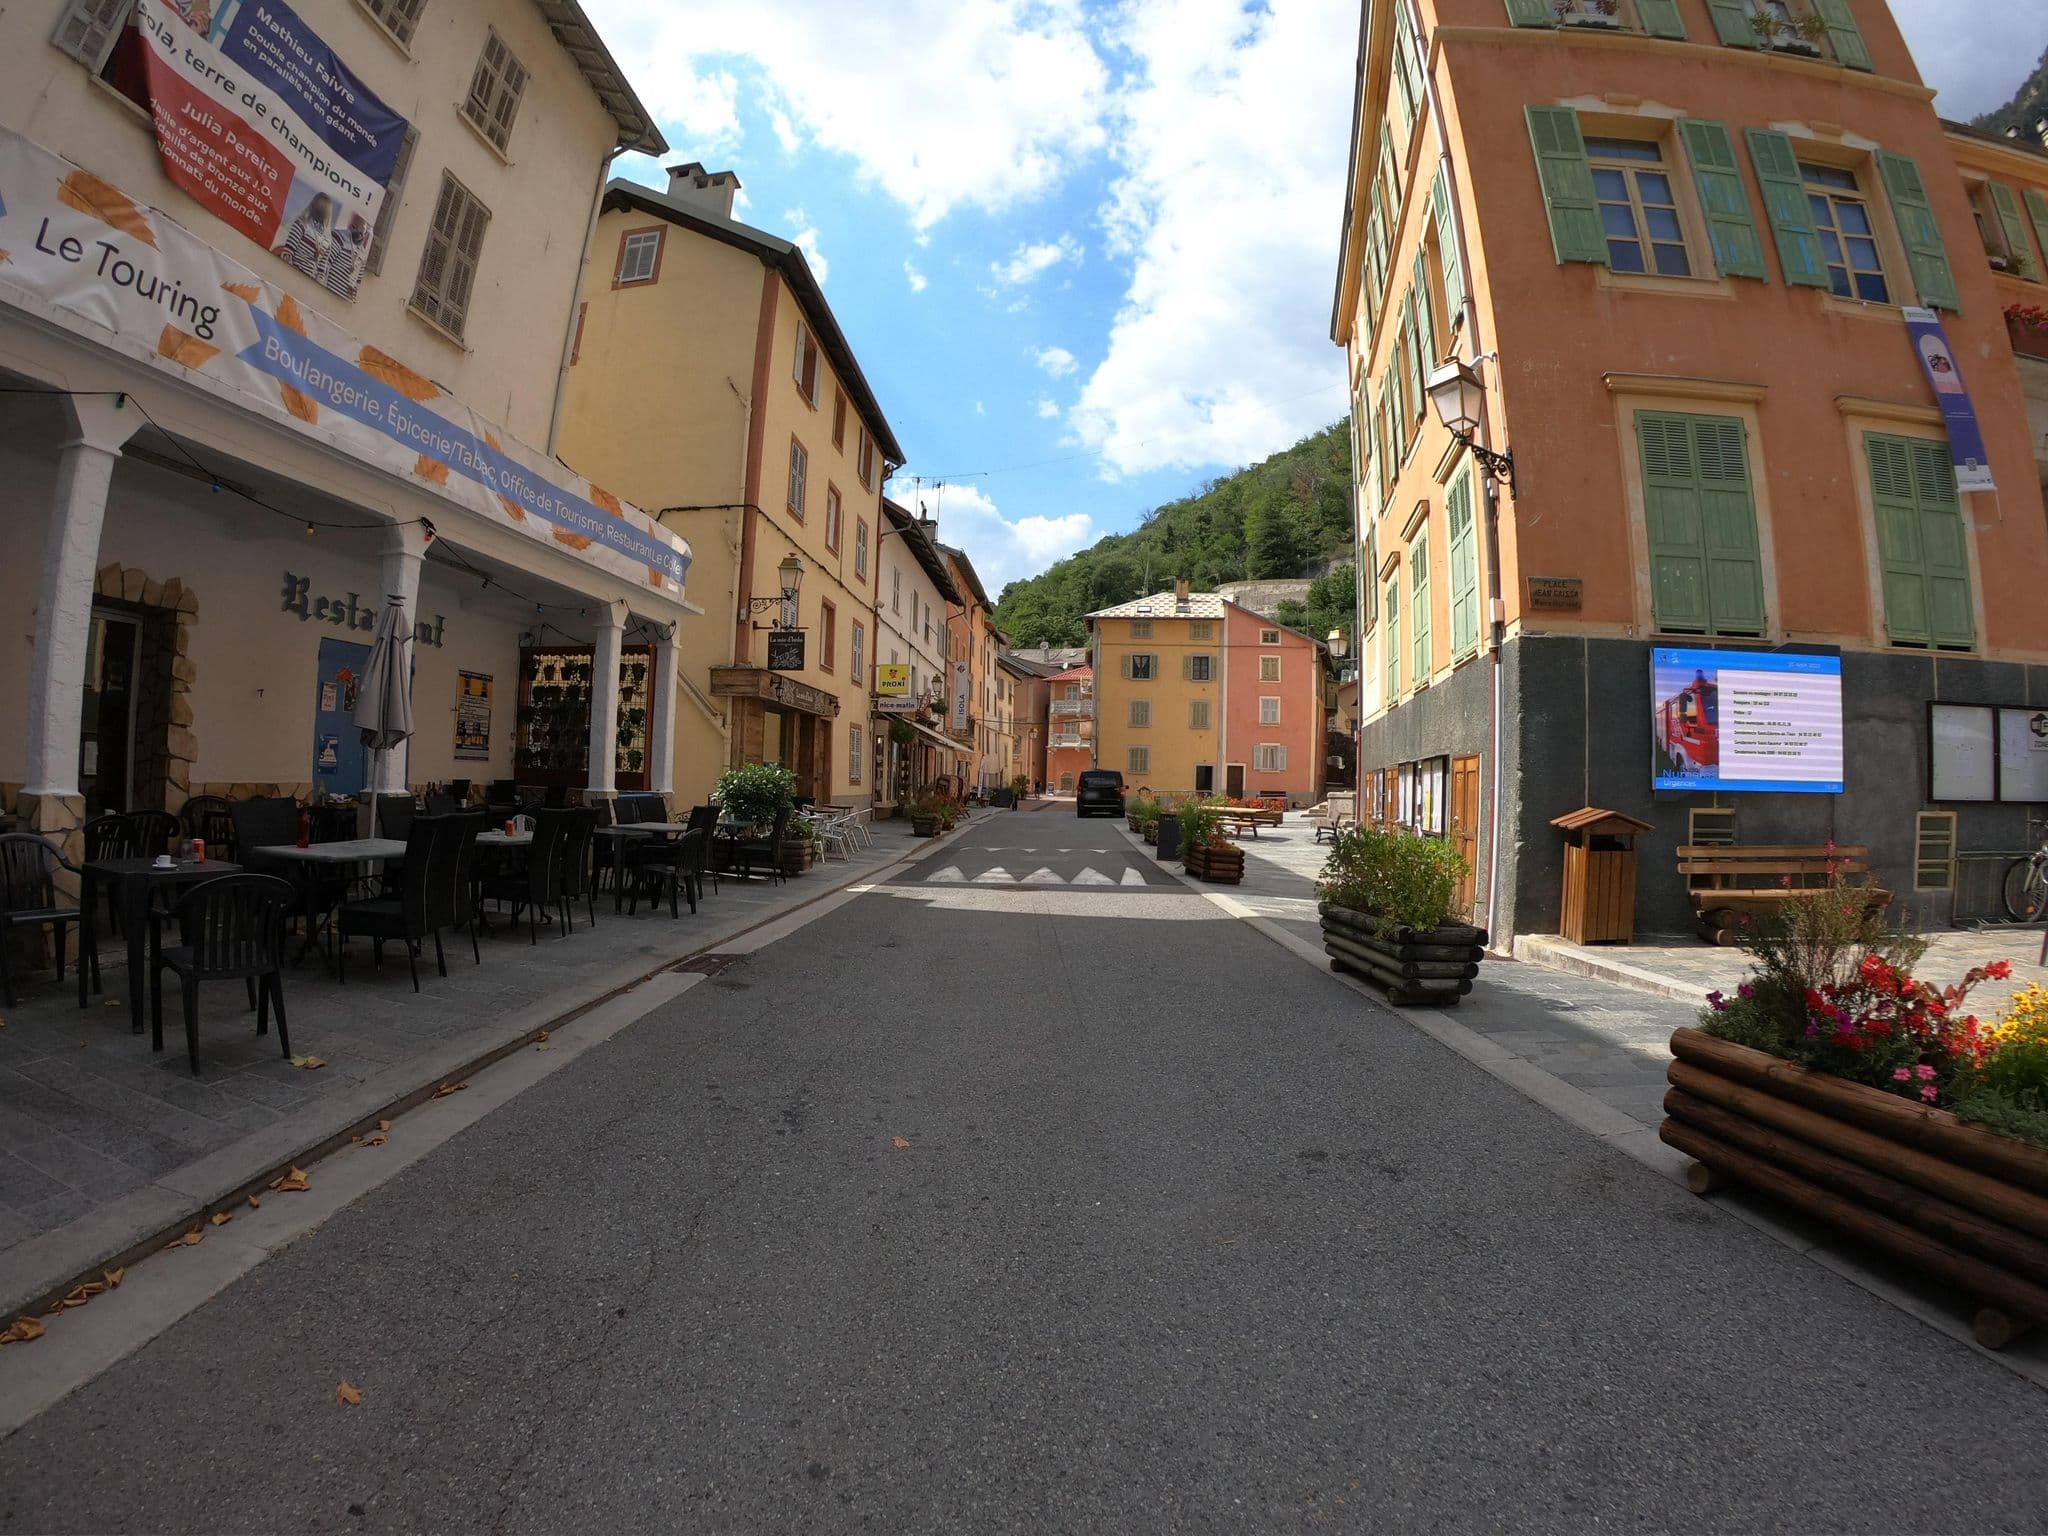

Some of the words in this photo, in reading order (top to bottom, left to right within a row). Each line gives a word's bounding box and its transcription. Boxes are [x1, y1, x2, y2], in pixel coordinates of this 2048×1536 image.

[243, 37, 257, 54] en
[257, 51, 303, 94] parallèle
[303, 90, 314, 105] et
[314, 99, 326, 119] en
[326, 113, 357, 144] géant.
[248, 24, 286, 63] Double
[286, 58, 331, 107] champion
[331, 104, 347, 120] du
[346, 114, 378, 149] monde
[255, 6, 314, 65] Mathieu
[315, 61, 356, 104] Faivre
[138, 3, 177, 55] sola,
[183, 48, 236, 95] terre
[241, 92, 267, 117] de
[271, 115, 361, 199] champions
[364, 192, 373, 206] !
[181, 101, 223, 136] Julia
[225, 131, 279, 181] Pereira
[189, 151, 205, 167] de
[207, 162, 247, 196] bronze
[247, 192, 269, 213] aux
[204, 178, 220, 195] du
[220, 191, 263, 227] monde.
[229, 163, 252, 184] aux
[252, 179, 273, 200] J.O.
[35, 217, 83, 262] Le
[96, 240, 220, 340] Touring
[264, 335, 384, 422] Boulangerie,
[387, 400, 497, 489] Épicerie/Tabac,
[501, 470, 536, 504] Office
[536, 492, 552, 512] de
[554, 499, 606, 538] Tourisme,
[652, 549, 662, 565] Le
[880, 701, 915, 709] nice-matin
